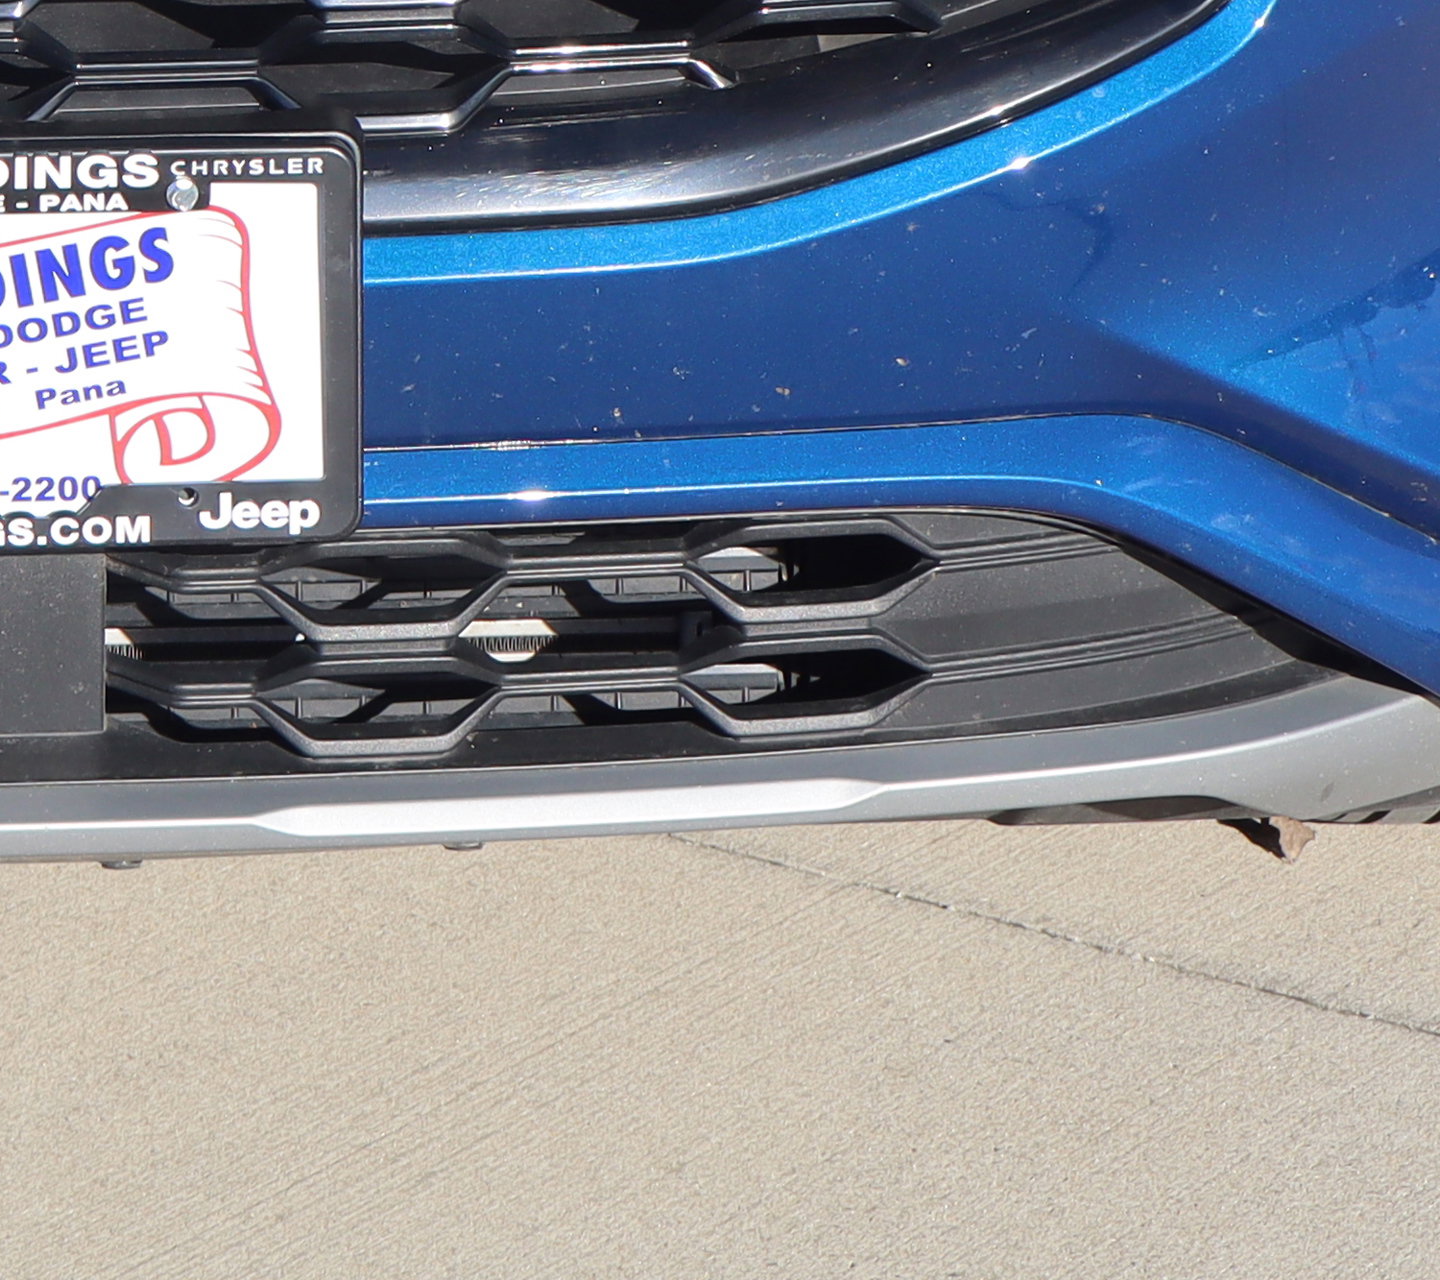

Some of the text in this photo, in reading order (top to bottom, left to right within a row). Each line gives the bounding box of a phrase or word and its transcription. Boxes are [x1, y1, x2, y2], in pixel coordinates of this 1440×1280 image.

[170, 157, 324, 177] CHRYSLER
[39, 192, 129, 212] PANA
[55, 329, 170, 374] JEEP
[36, 378, 128, 411] Pana
[199, 492, 321, 535] Jeep
